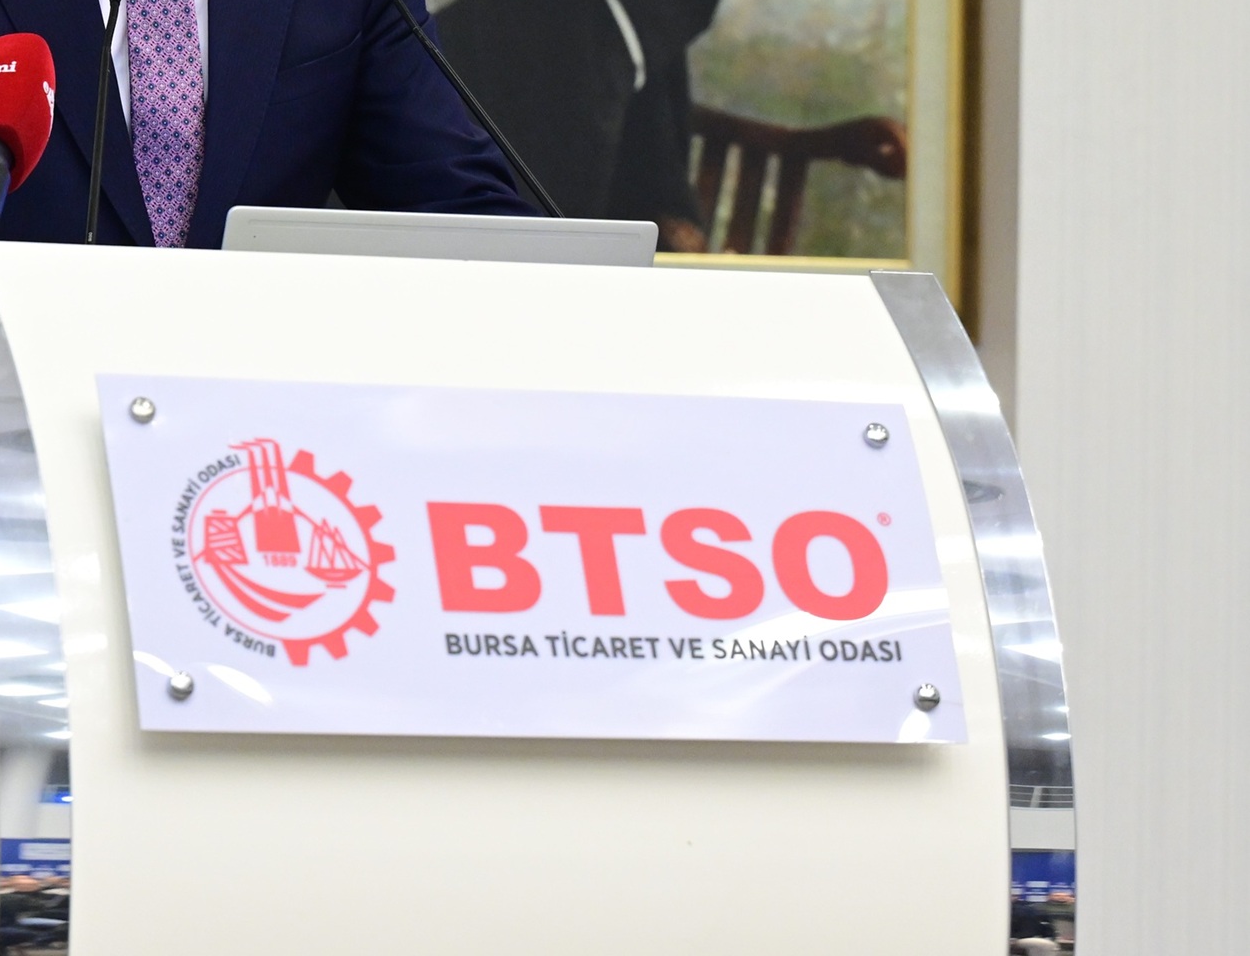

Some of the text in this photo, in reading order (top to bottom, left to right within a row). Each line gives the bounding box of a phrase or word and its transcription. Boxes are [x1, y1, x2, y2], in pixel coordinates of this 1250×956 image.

[171, 453, 277, 658] BURSA TİCARET VE SANAYİ ODASI
[426, 501, 889, 621] BTSO
[445, 630, 903, 663] BURSA TİCARET VE SANAYİ ODASI
